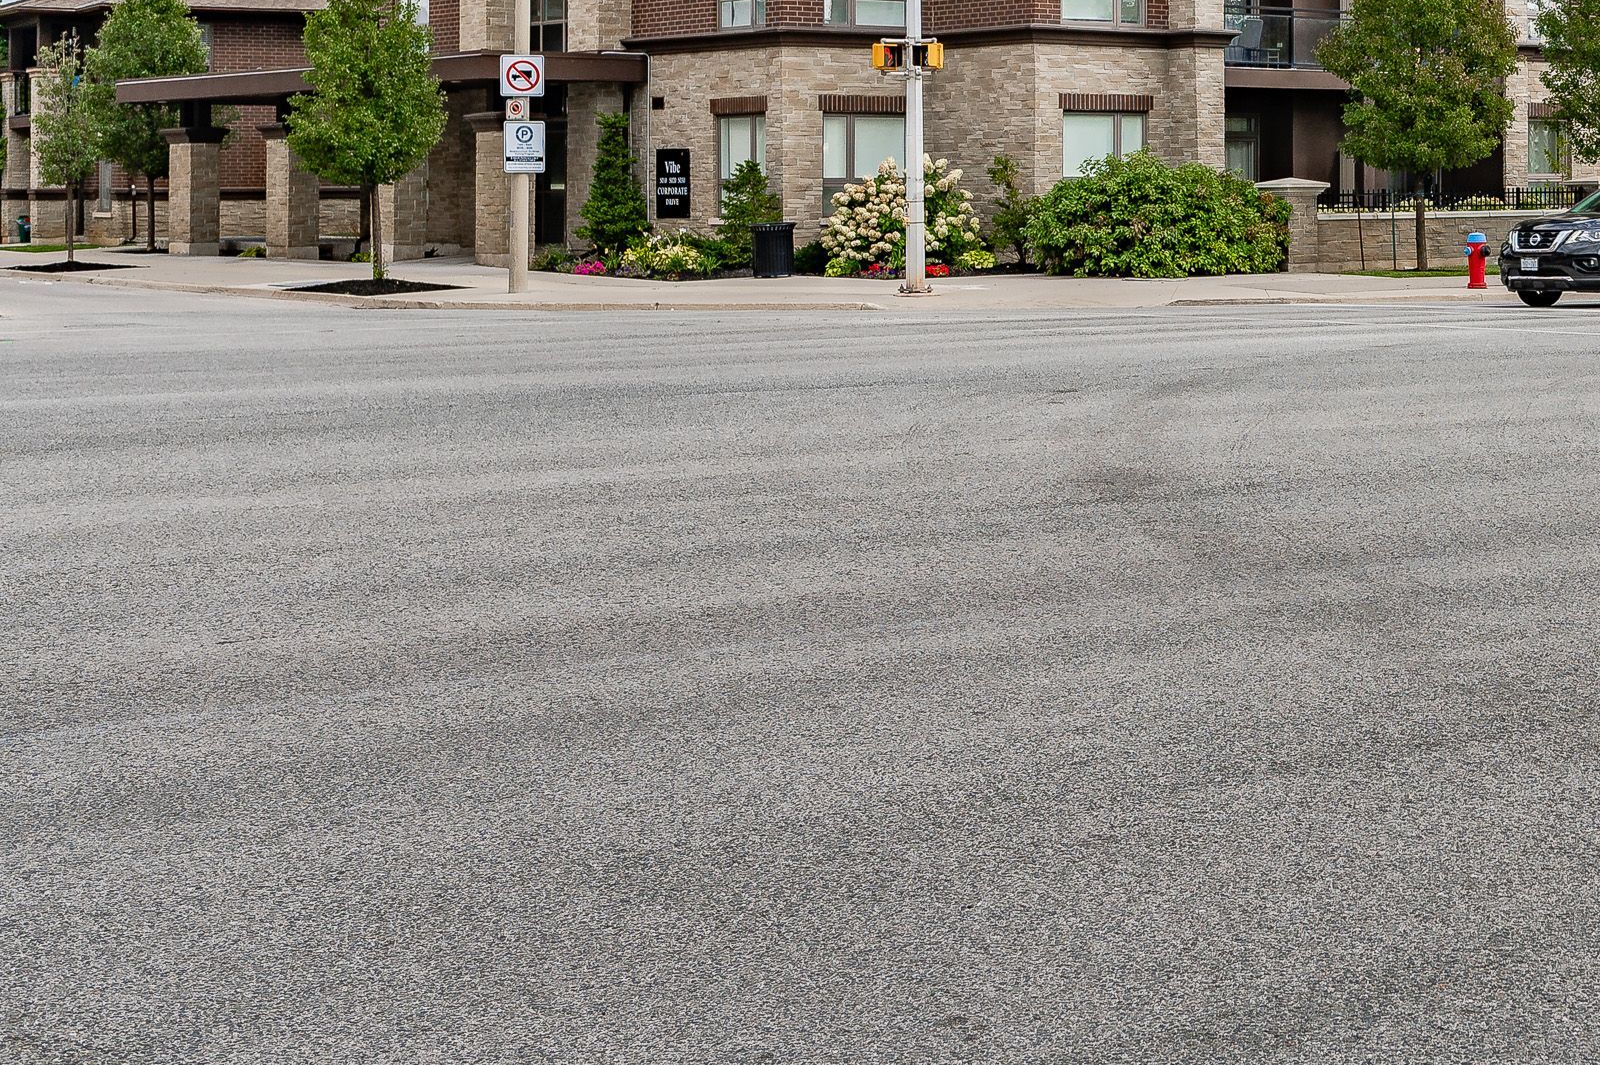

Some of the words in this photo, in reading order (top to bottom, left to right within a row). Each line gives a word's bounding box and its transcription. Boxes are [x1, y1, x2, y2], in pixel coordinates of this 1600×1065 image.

[521, 130, 528, 138] P
[664, 161, 681, 173] Vibe
[657, 187, 688, 195] CORPORATE
[665, 198, 679, 206] DRIVE
